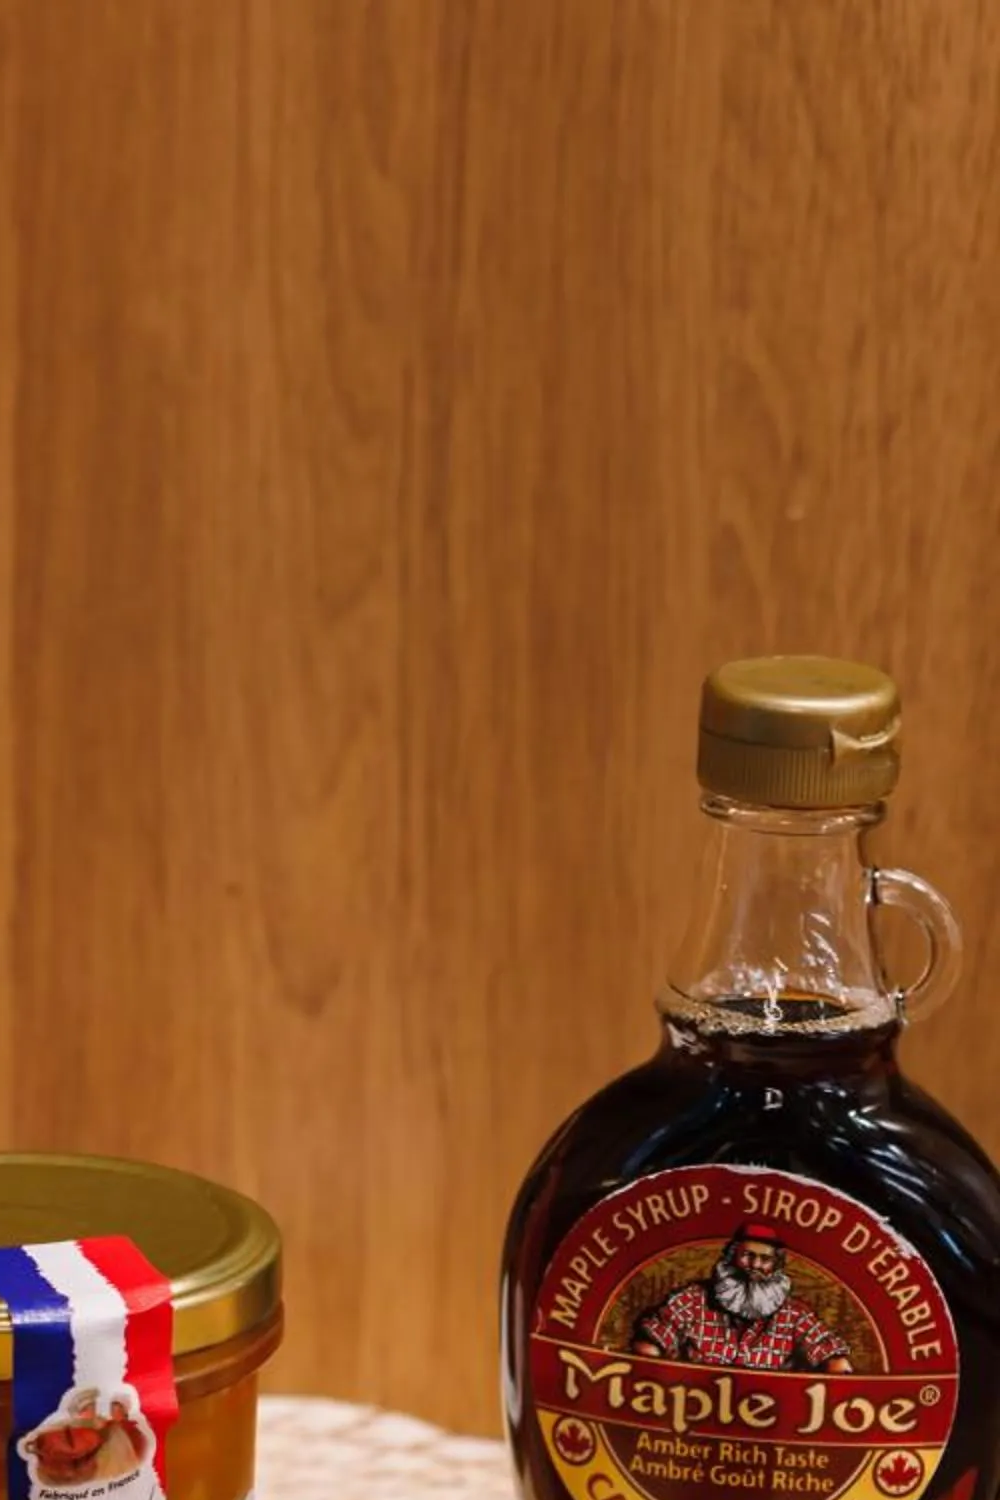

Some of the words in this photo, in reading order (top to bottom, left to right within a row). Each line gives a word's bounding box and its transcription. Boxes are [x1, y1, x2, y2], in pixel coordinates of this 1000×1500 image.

[551, 1231, 617, 1328] MAPLE
[612, 1184, 710, 1241] SYRUP
[743, 1184, 843, 1234] SIROP
[558, 1349, 776, 1433] Maple
[630, 1454, 704, 1483] Ambré
[710, 1465, 765, 1488] Goût
[772, 1471, 835, 1493] Riche
[637, 1432, 712, 1459] Amber
[719, 1442, 767, 1465] Rich
[775, 1447, 829, 1469] Taste
